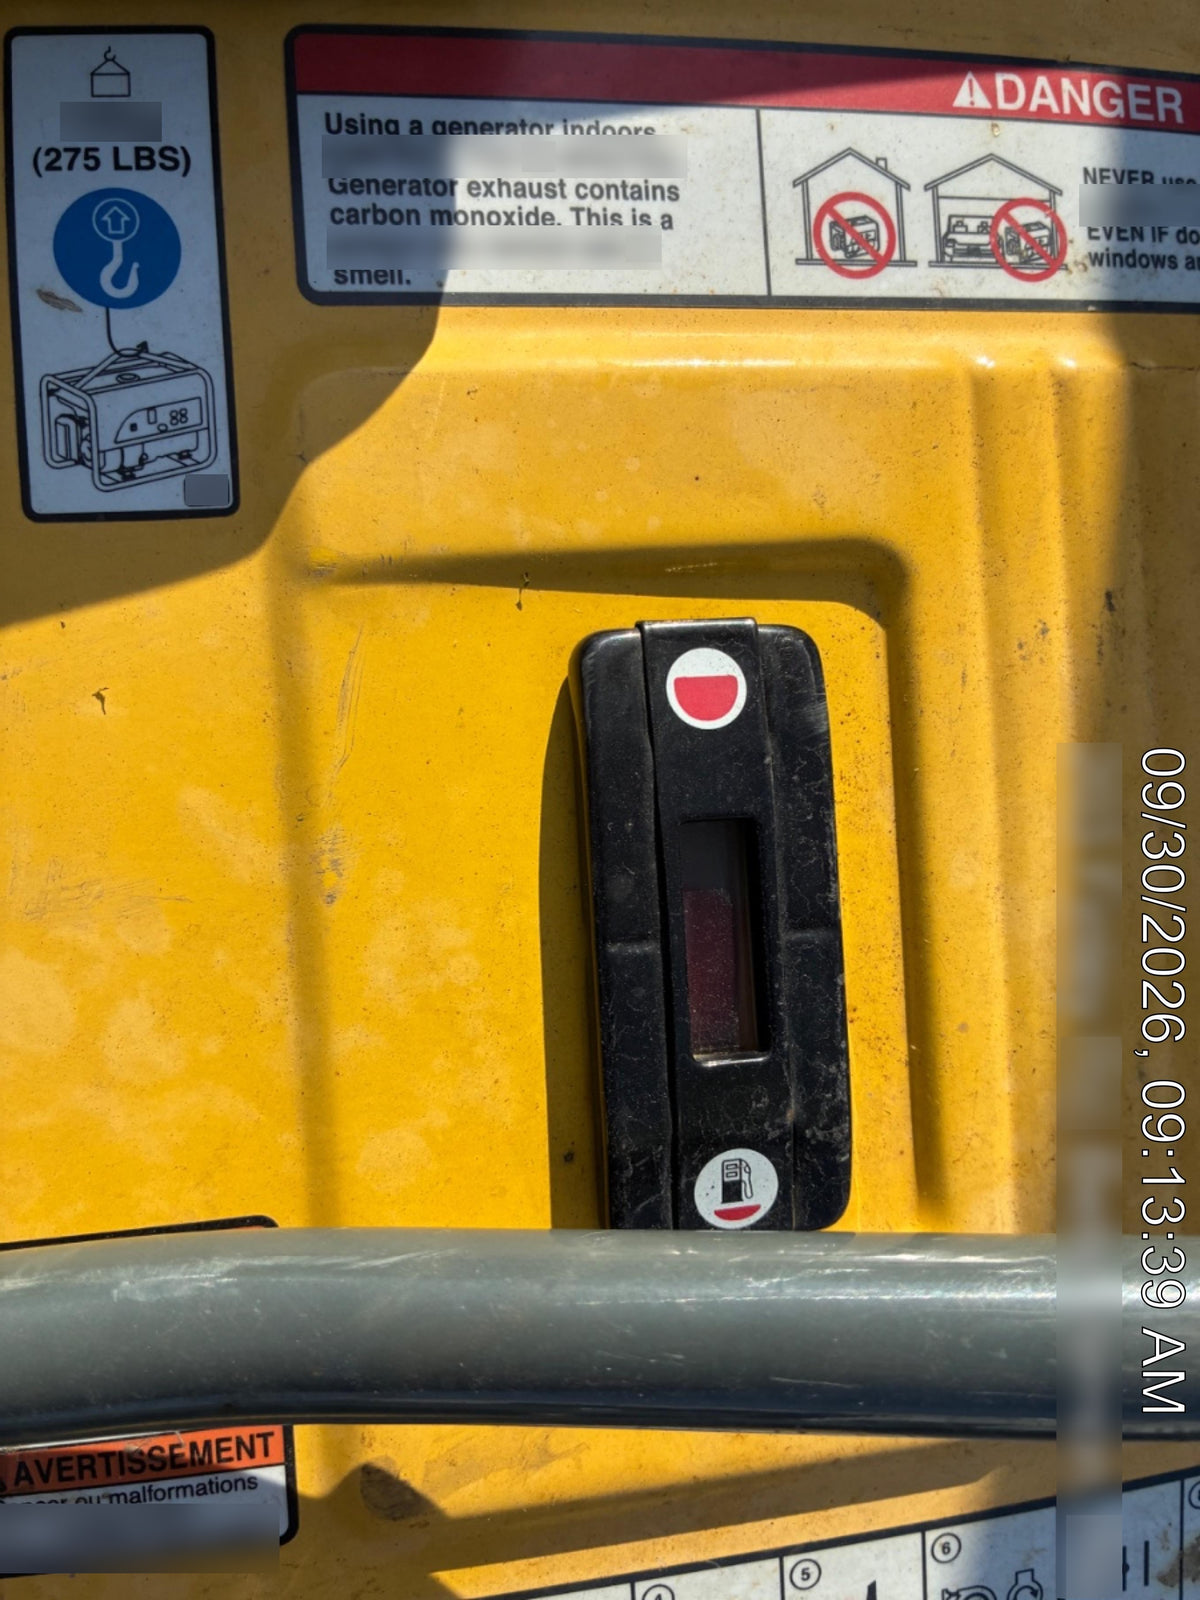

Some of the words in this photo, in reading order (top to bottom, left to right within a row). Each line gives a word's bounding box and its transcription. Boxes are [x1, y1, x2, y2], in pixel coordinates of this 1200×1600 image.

[994, 71, 1184, 124] DANGER
[325, 112, 399, 135] Using
[409, 119, 423, 135] a
[432, 115, 554, 135] generator
[33, 146, 101, 177] (275
[113, 146, 192, 177] LBS)
[1083, 167, 1154, 184] NEVER
[328, 178, 458, 197] Generator
[467, 178, 567, 200] exhaust
[575, 179, 680, 201] contains
[330, 203, 420, 225] carbon
[430, 206, 561, 225] monoxide.
[569, 207, 623, 225] This
[632, 208, 652, 225] is
[661, 213, 673, 230] a
[1087, 226, 1144, 242] EVEN
[1152, 226, 1169, 243] IF
[1088, 247, 1178, 270] windows
[14, 1431, 275, 1487] AVERTISSEMENT
[109, 1476, 258, 1504] malformations
[941, 1541, 951, 1555] 6
[800, 1567, 811, 1581] 5
